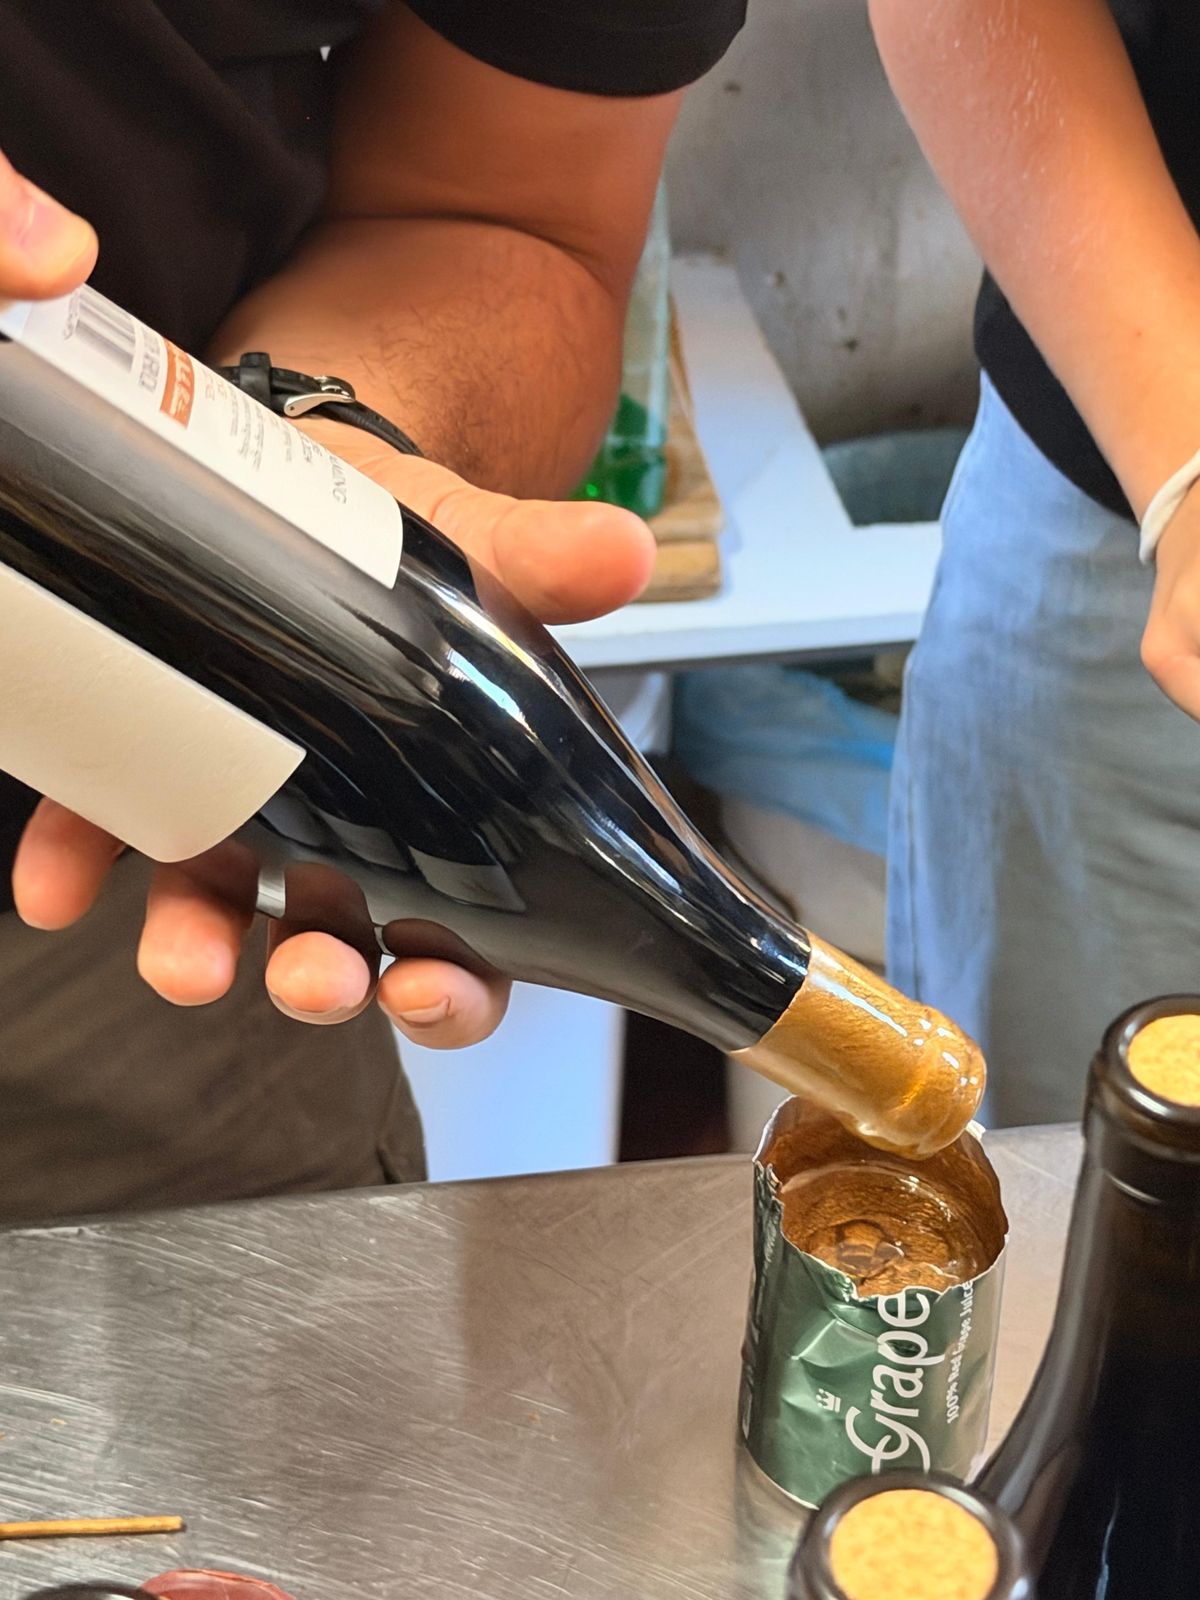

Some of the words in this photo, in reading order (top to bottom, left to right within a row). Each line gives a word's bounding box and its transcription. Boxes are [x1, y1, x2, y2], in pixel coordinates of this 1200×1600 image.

[959, 1279, 973, 1317] Juice
[952, 1317, 972, 1355] Grape
[845, 1287, 945, 1475] Grape
[947, 1353, 962, 1382] Red
[945, 1381, 960, 1424] 100%
